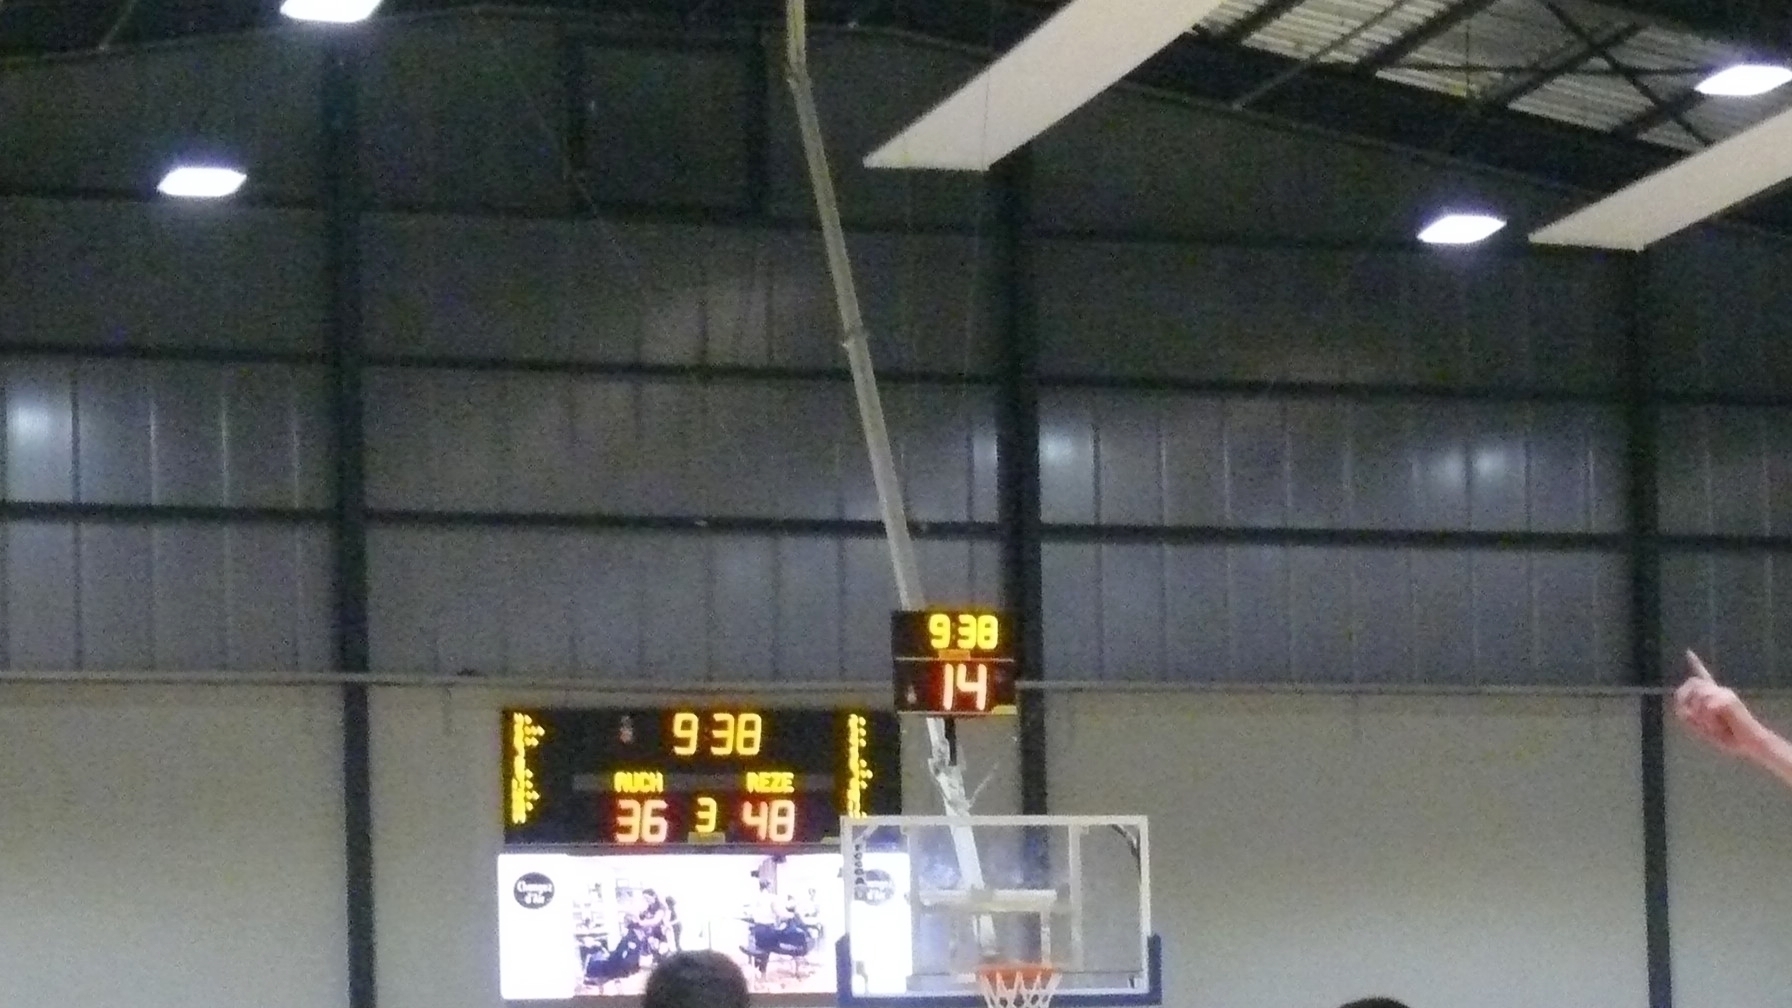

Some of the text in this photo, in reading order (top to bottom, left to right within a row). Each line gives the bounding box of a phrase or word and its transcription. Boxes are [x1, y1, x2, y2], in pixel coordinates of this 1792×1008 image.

[928, 614, 999, 650] 9:38
[942, 663, 988, 711] 14
[614, 771, 664, 793] AUCH
[746, 771, 795, 793] REZE
[616, 799, 668, 843] 36
[695, 797, 717, 833] 3
[741, 799, 796, 843] 48
